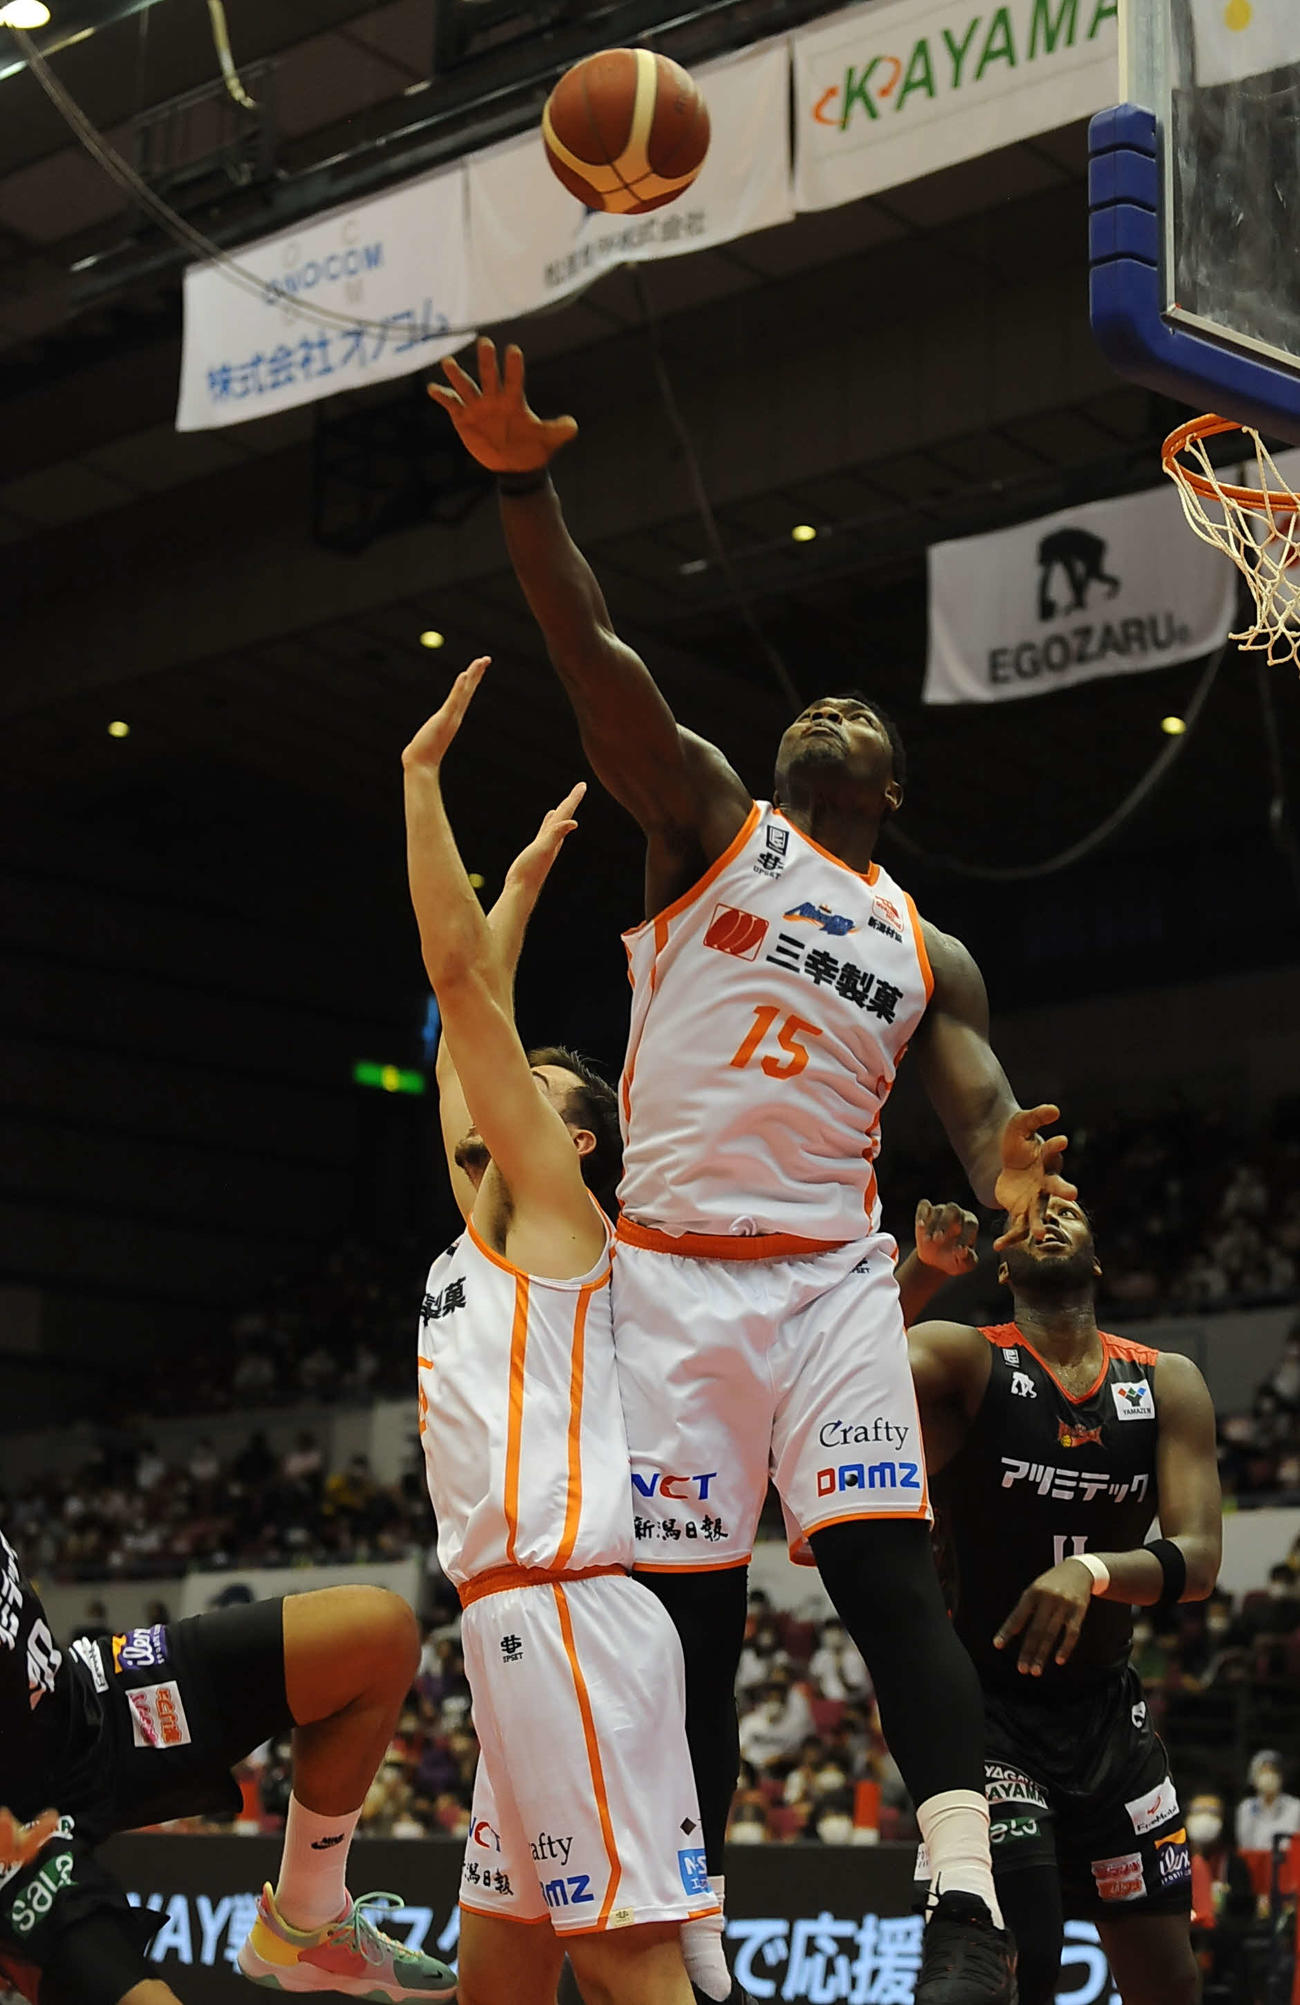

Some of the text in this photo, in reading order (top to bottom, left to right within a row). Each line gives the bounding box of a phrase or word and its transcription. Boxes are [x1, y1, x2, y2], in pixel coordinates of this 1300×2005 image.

[206, 297, 451, 402] 株式会社オノコム
[988, 612, 1177, 684] EGOZARU
[765, 932, 904, 1025] 三幸製菓
[729, 1004, 824, 1081] 15
[819, 1417, 910, 1450] Crafty
[1001, 1456, 1149, 1503] アツミテック
[633, 1514, 728, 1541] 新潟日報
[528, 1832, 574, 1866] afty
[464, 1862, 514, 1896] 潟日報
[540, 1875, 594, 1907] MZ
[726, 1911, 925, 2004] で応援
